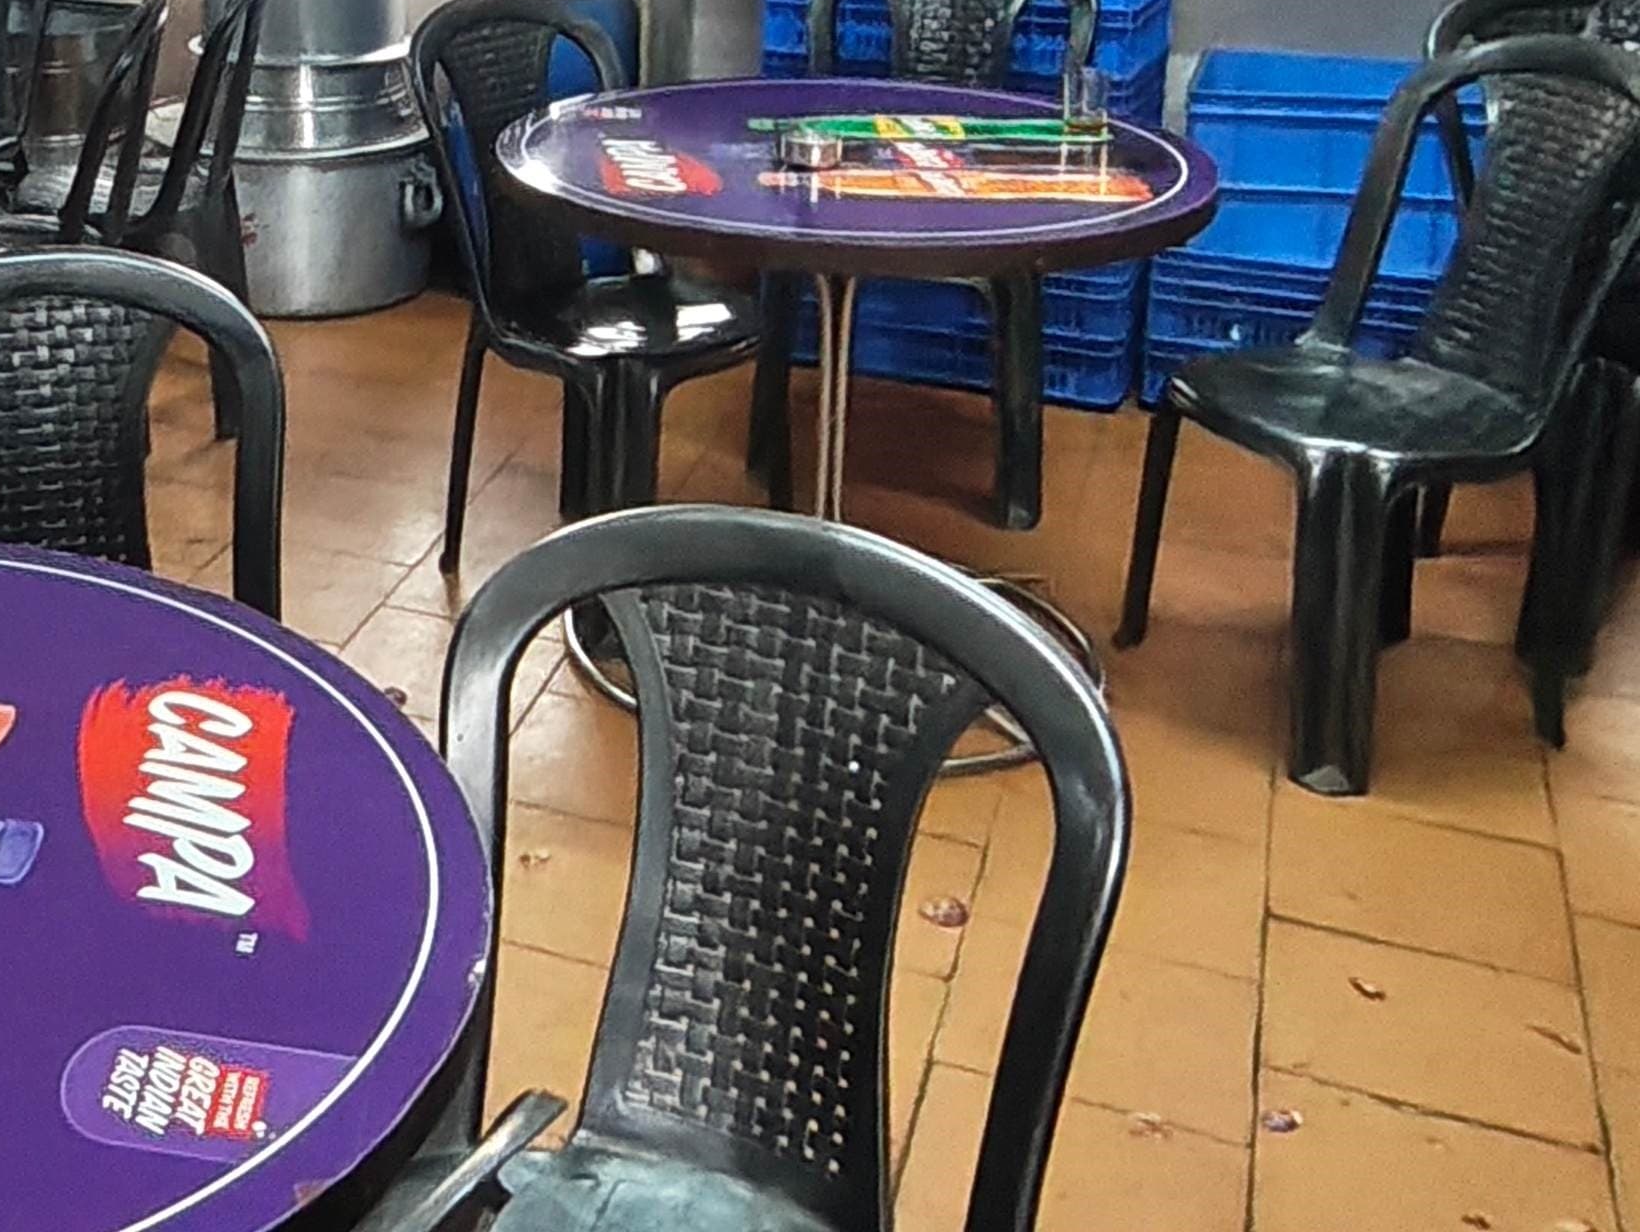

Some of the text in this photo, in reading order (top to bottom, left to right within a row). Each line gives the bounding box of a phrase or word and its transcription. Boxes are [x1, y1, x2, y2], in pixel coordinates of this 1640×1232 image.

[123, 691, 255, 916] CAMPA
[102, 1048, 150, 1119] TASTE
[135, 1046, 187, 1135] INDIAN
[175, 1056, 221, 1136] GREAT
